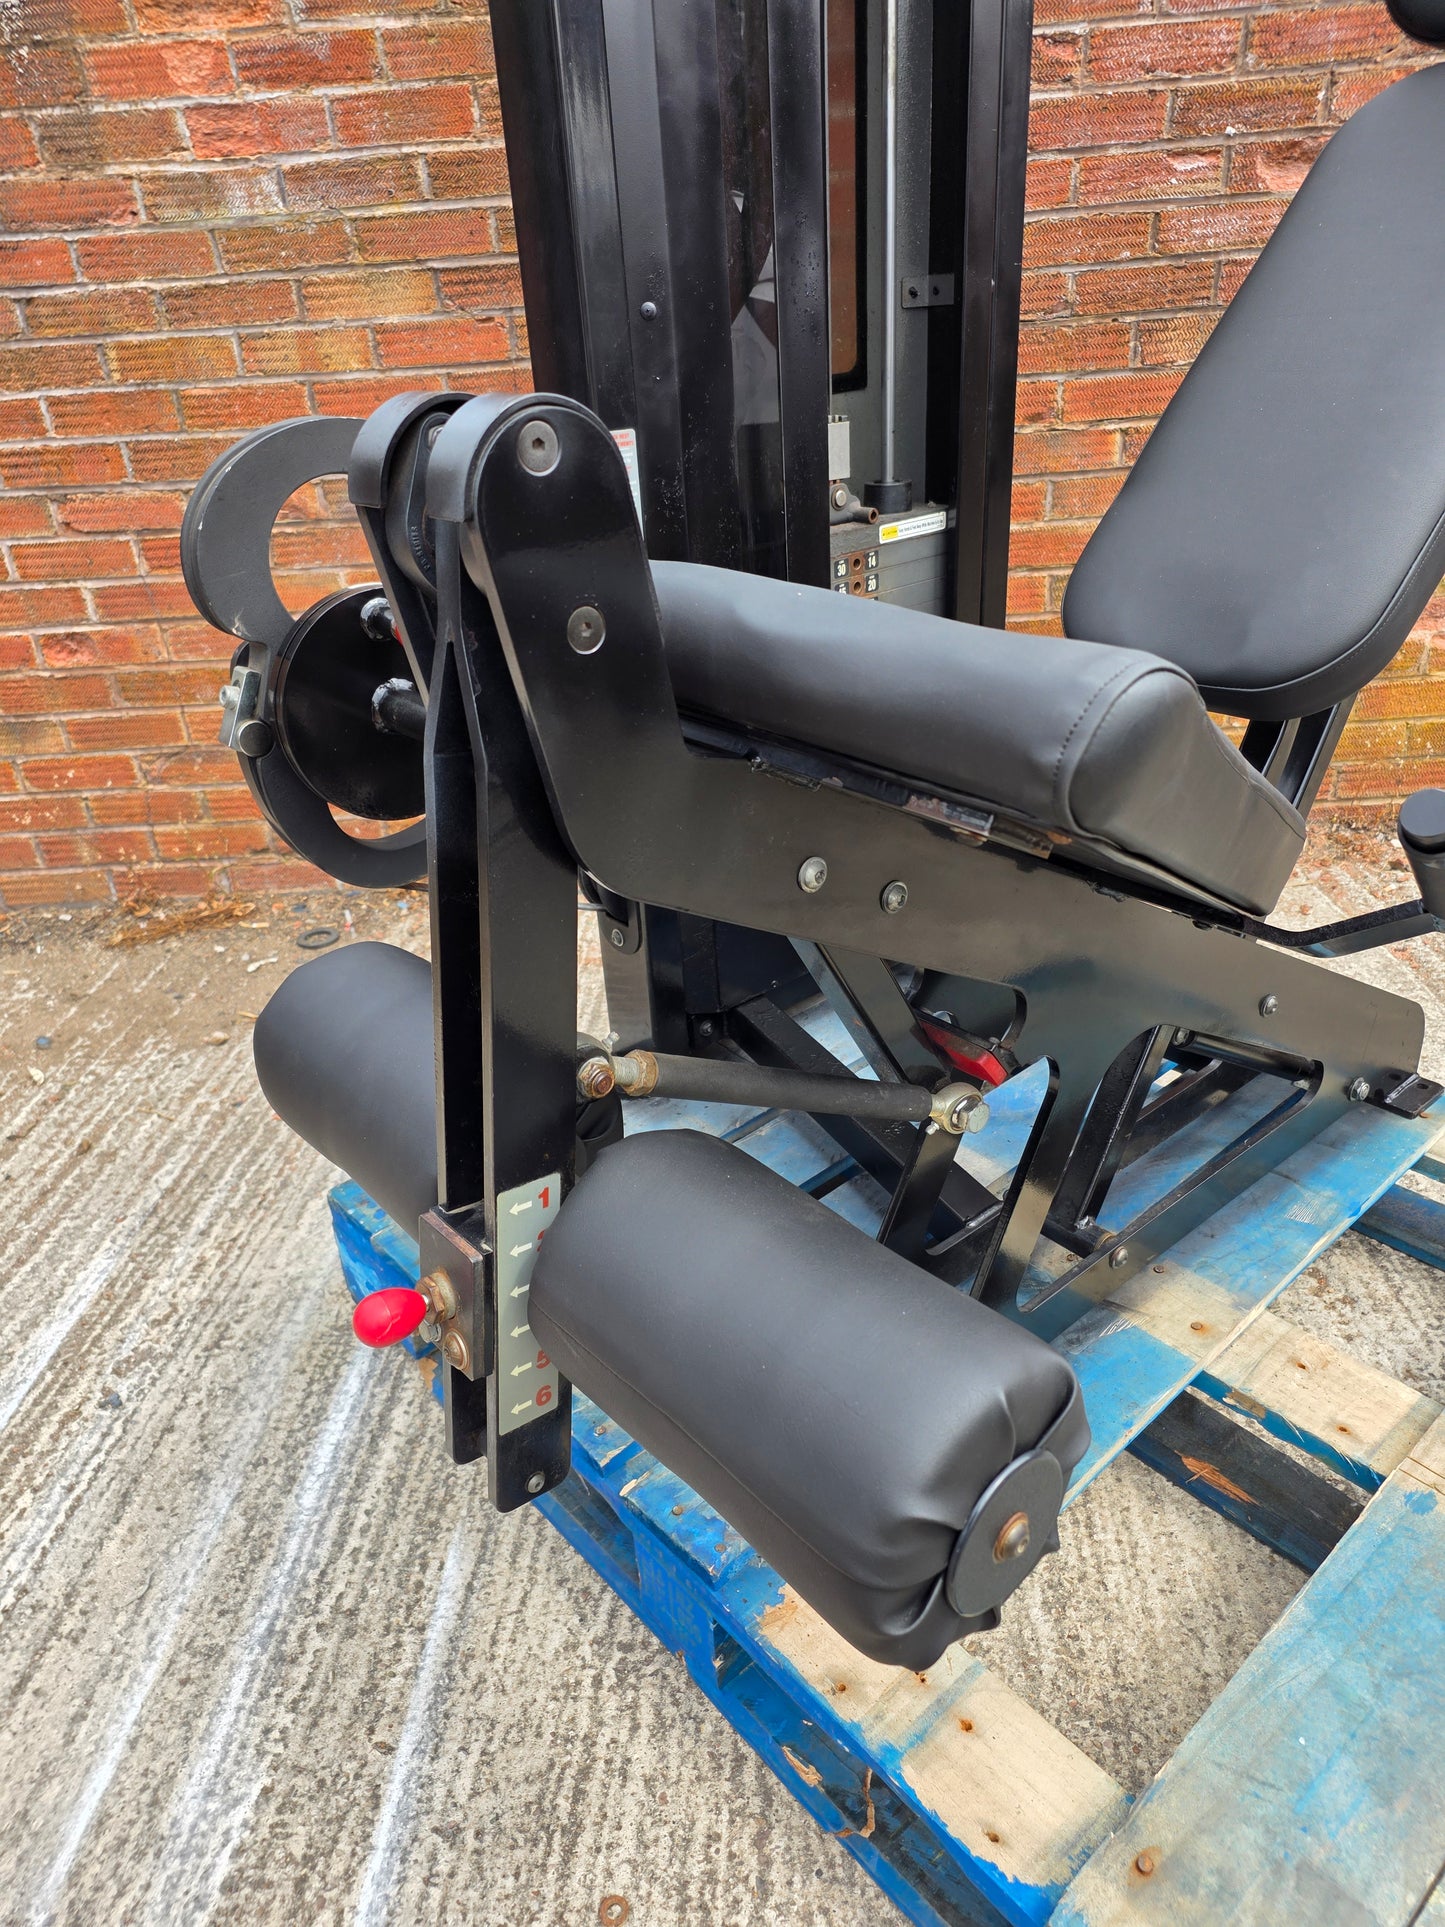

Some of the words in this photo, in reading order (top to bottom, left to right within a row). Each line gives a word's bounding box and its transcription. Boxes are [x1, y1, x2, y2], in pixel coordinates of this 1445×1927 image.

[868, 556, 876, 568] 14
[837, 564, 846, 577] 30
[868, 579, 876, 591] 20
[538, 1187, 549, 1209] 1
[536, 1350, 551, 1370] 5
[536, 1385, 552, 1407] 6
